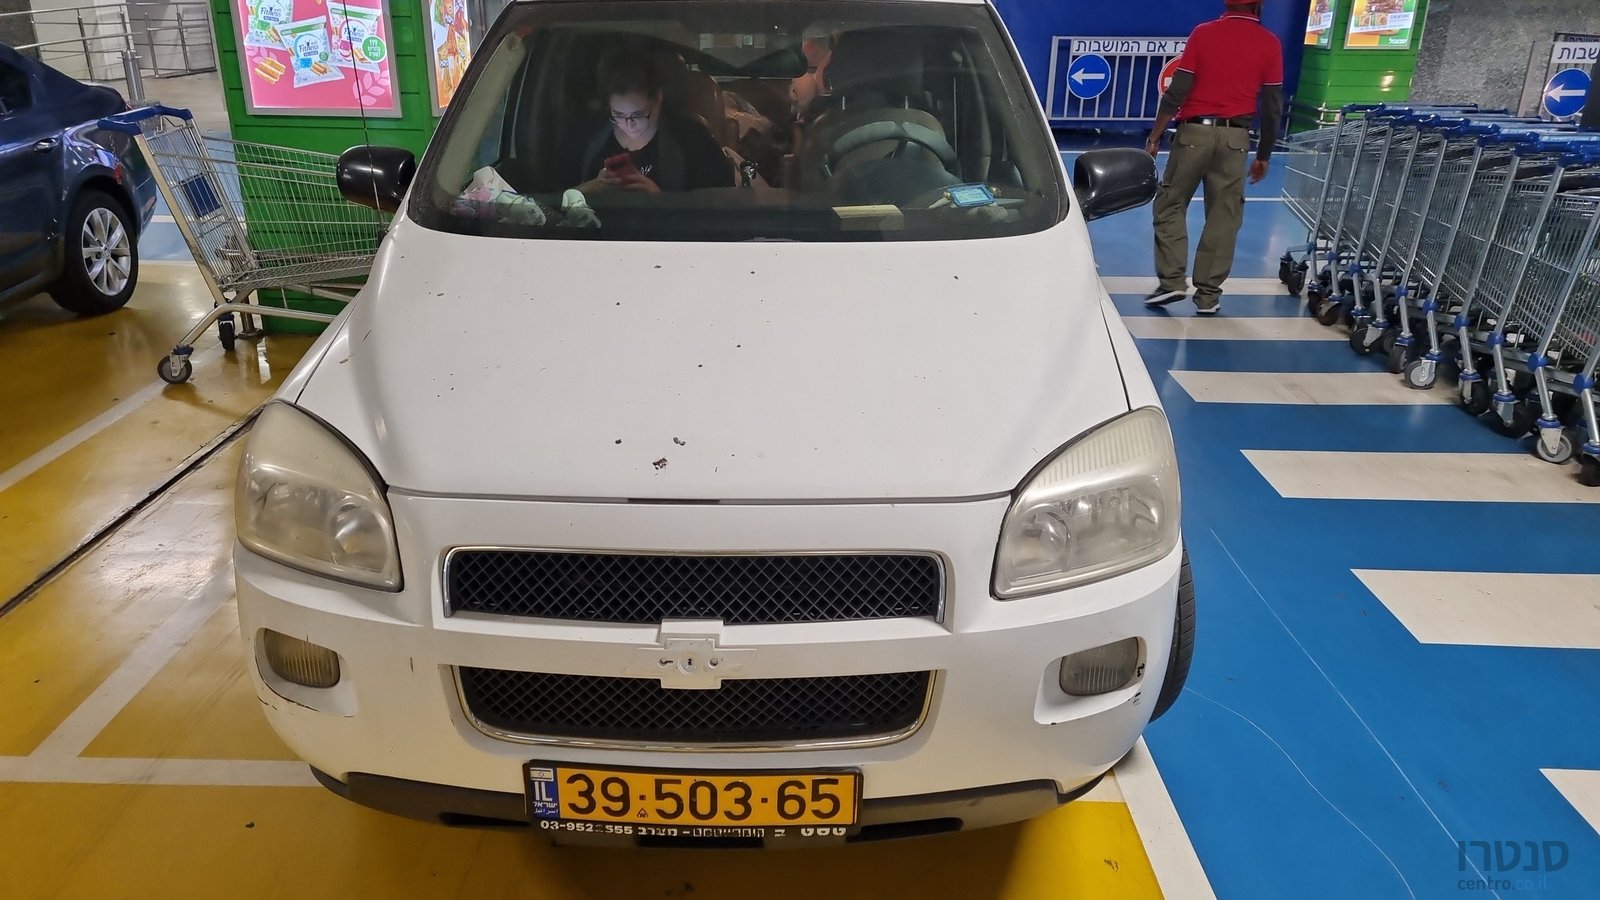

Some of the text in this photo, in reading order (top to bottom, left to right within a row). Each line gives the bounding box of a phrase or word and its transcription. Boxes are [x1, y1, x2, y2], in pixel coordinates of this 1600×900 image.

[298, 43, 320, 53] Fitness
[1075, 40, 1141, 52] המושבות
[1146, 41, 1168, 52] אם
[534, 781, 553, 801] IL
